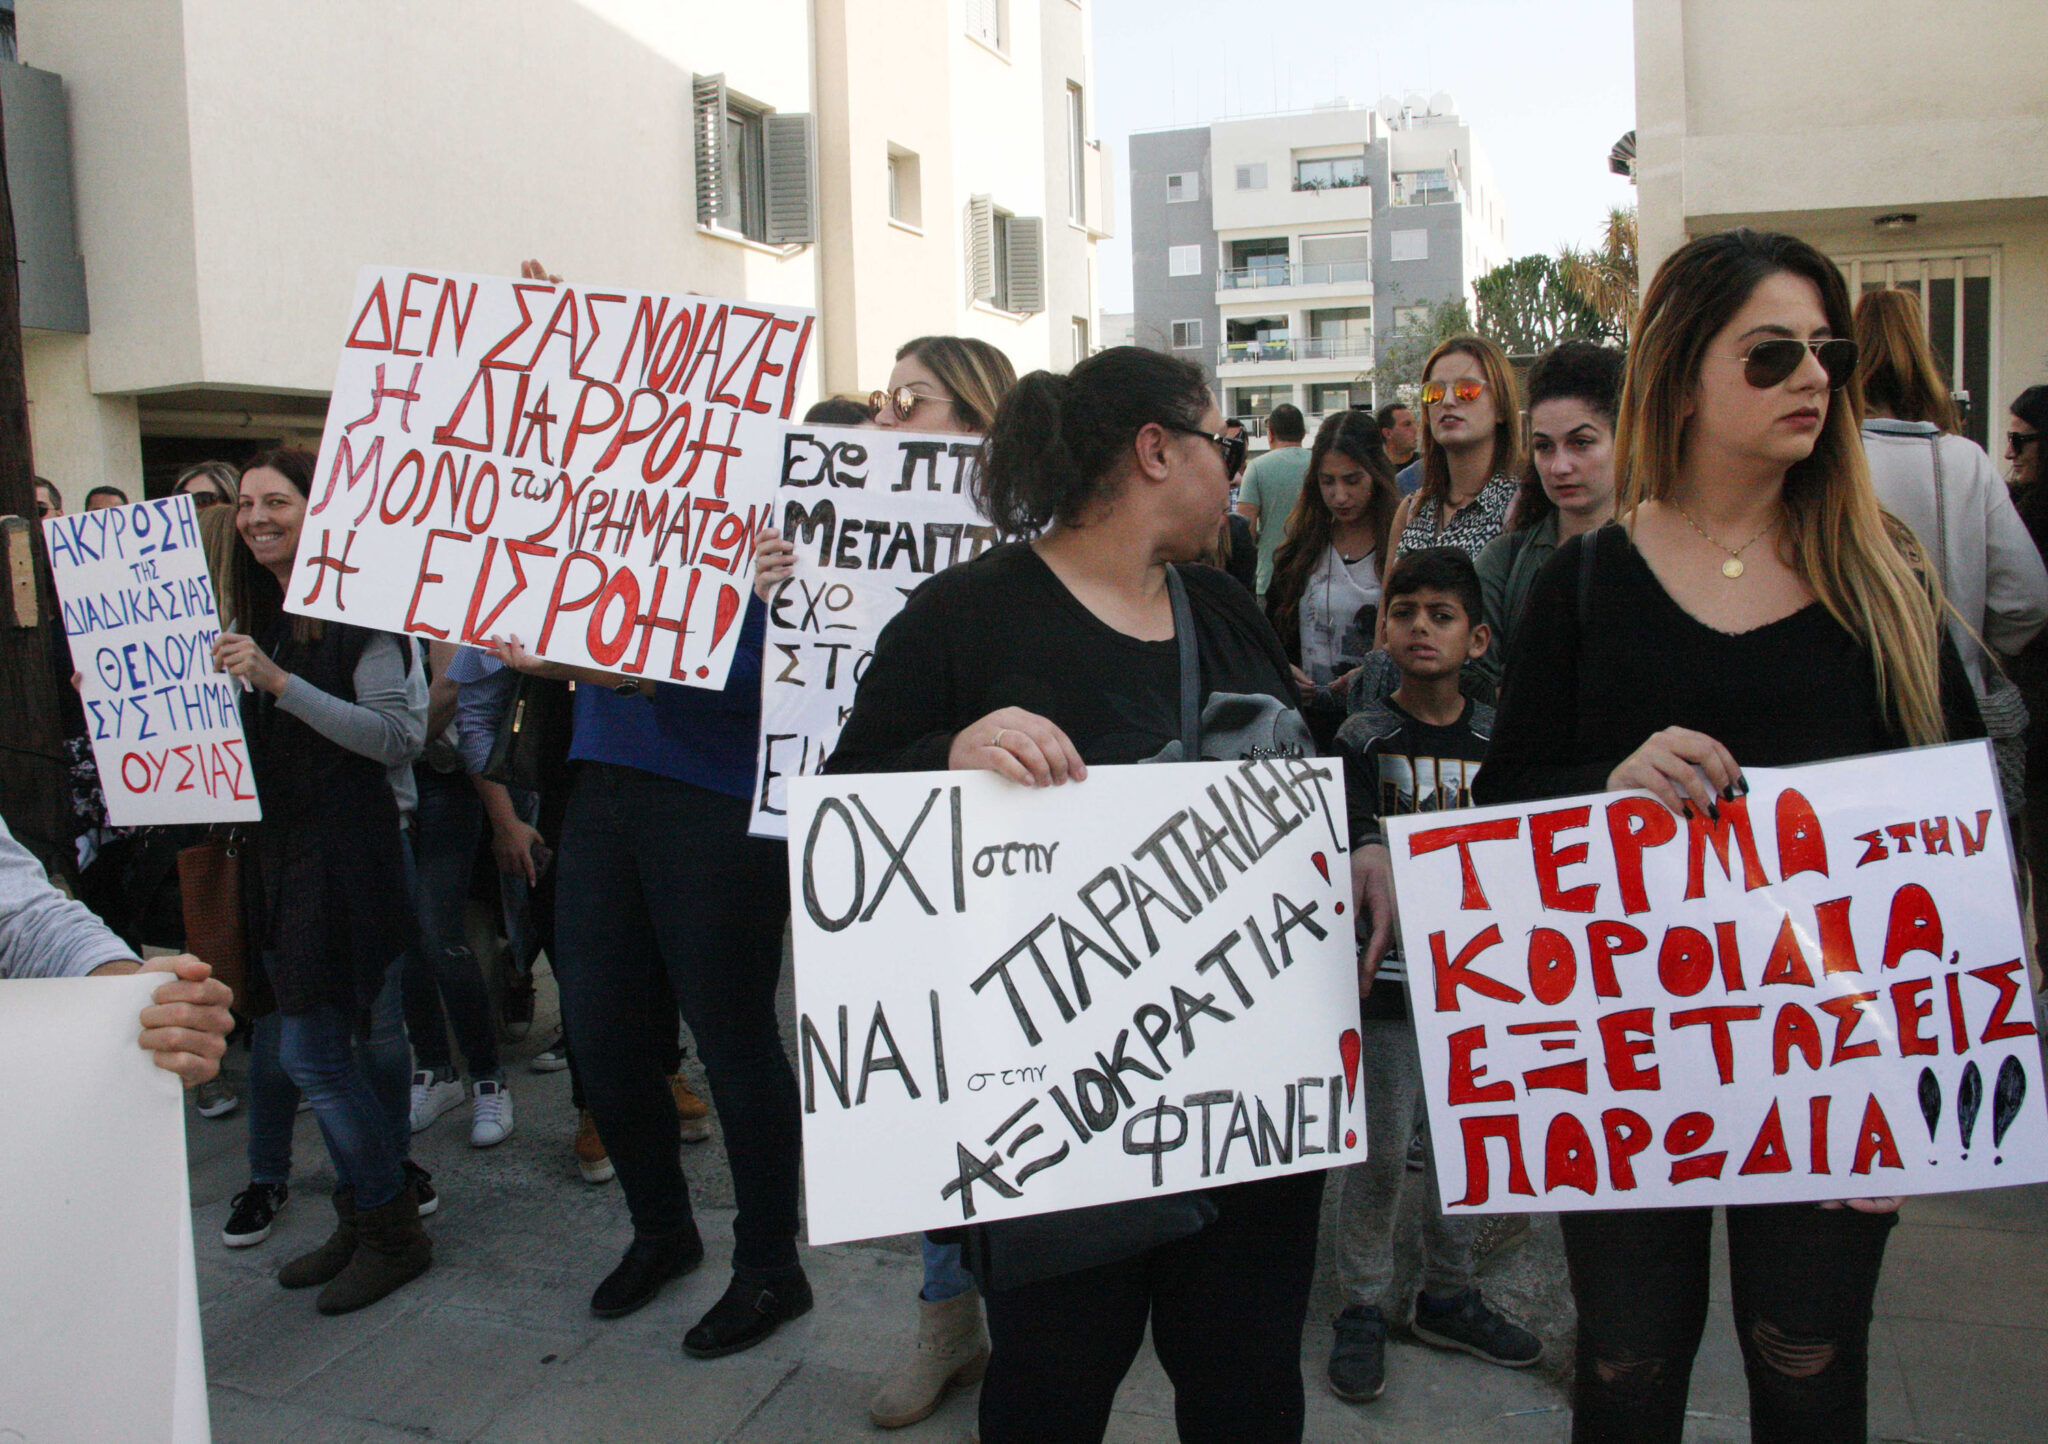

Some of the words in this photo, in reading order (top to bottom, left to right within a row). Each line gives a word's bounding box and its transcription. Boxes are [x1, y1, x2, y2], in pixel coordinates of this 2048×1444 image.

[345, 273, 478, 358] ΔΕΝ
[479, 283, 627, 383] ΣΑΣ
[613, 295, 816, 420] ΝΟΙΑΖΕΙ
[310, 434, 500, 535] ΜΟΝΟ
[344, 362, 423, 434] Η
[432, 366, 743, 499] ΔΙΑΡΡΟΗ
[51, 496, 198, 568] ΑΚΥΡΩΣΗ
[129, 558, 159, 584] ΤΗΣ
[783, 499, 1001, 573] ΜΕΤΑΠΤ
[63, 575, 215, 636] ΔΙΑΔΙΚΑΣΙΑΣ
[303, 528, 361, 612] Η
[403, 527, 741, 681] ΕΙΣΡΟΗ!
[87, 682, 240, 740] ΣΥΣΤΗΜΑ
[121, 739, 256, 800] ΟΥΣΙΑΣ
[802, 786, 966, 933] ΟΧΙ
[972, 840, 1059, 880] στην
[1409, 787, 1829, 916] ΤΕΡΜΑ
[1855, 809, 1992, 868] ΣΤΗΝ
[800, 989, 949, 1113] ΝΑΙ
[967, 1064, 1047, 1092] στην
[1122, 1028, 1361, 1187] ΦΤΑΝΕΙ!
